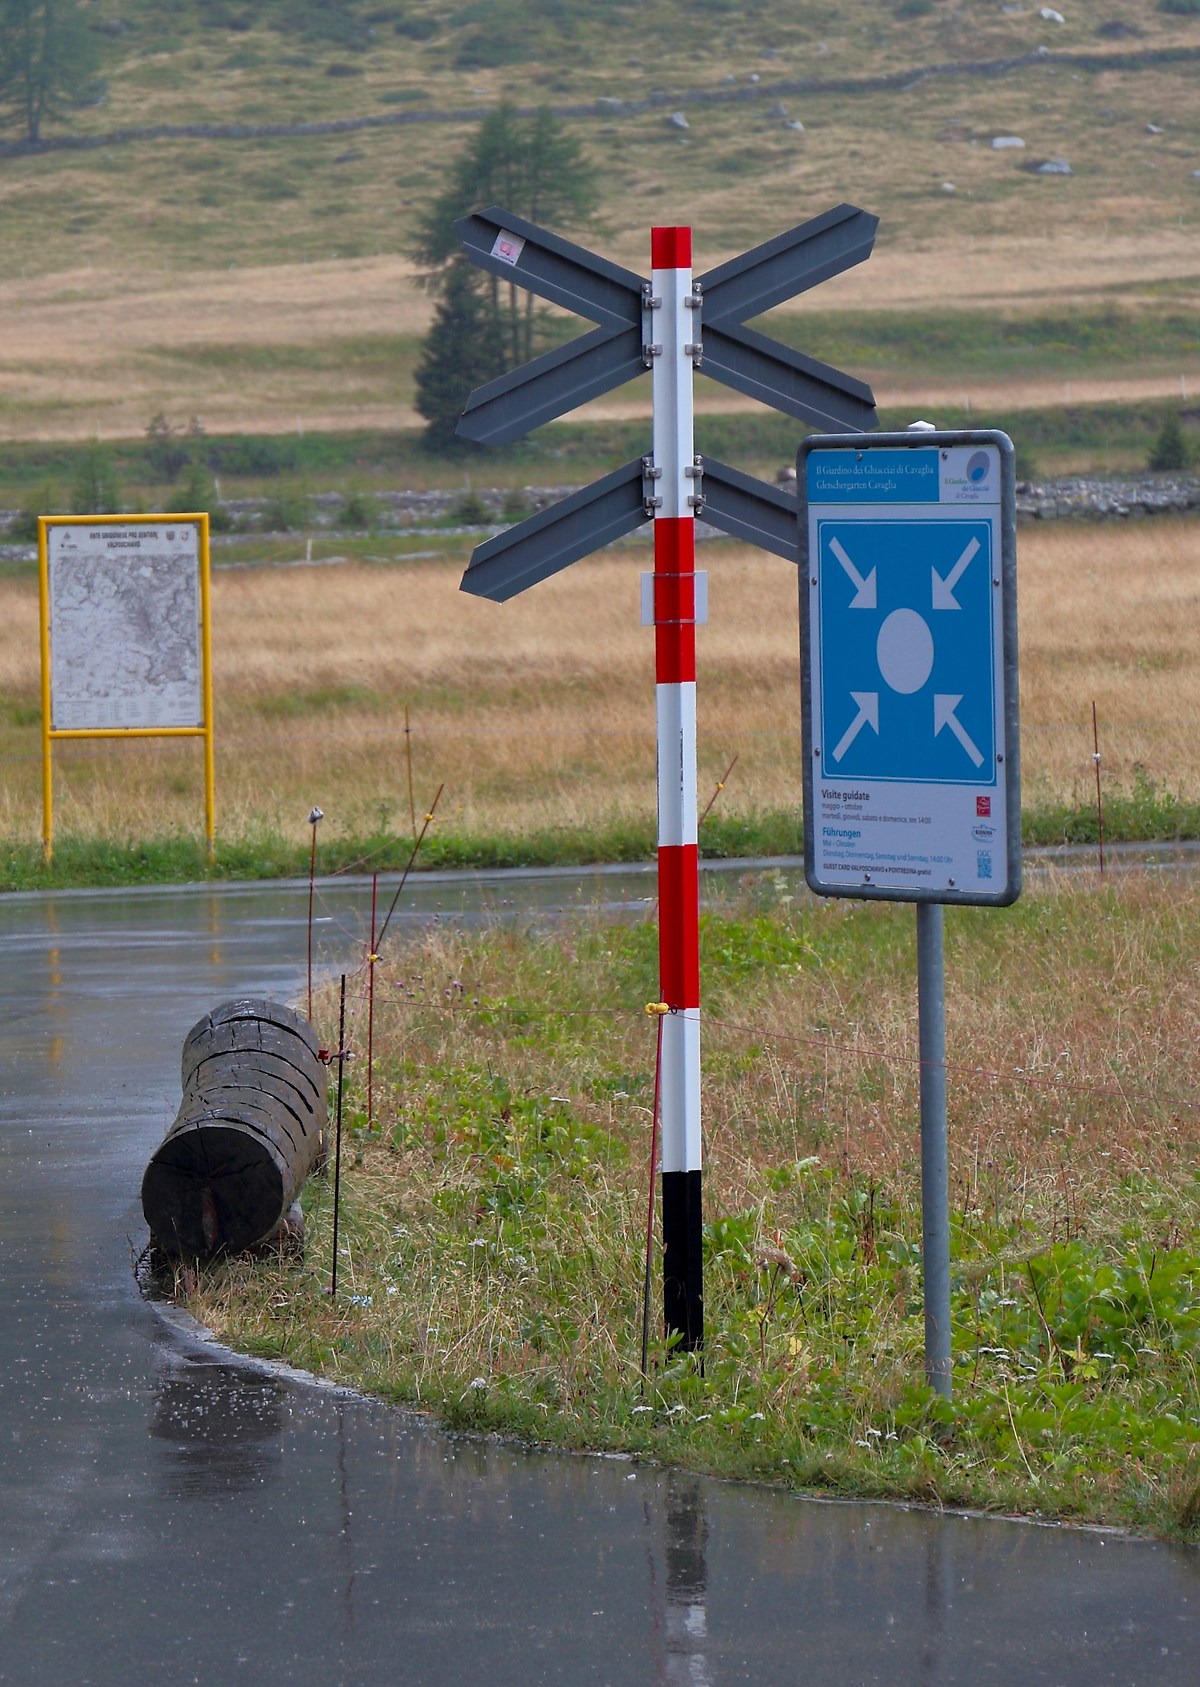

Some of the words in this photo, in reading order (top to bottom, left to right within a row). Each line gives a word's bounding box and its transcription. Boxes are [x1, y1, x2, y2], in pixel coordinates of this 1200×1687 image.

[816, 466, 821, 474] Il
[822, 465, 852, 475] Giardino
[853, 465, 863, 474] dei
[864, 465, 895, 474] Ghiacciai
[896, 464, 904, 474] di
[904, 464, 934, 477] Cavaglia
[816, 480, 867, 492] Gletschergarten
[868, 480, 896, 492] Cavaglia
[821, 789, 841, 799] Visite
[842, 790, 870, 801] guidate
[822, 803, 840, 811] maggio
[845, 803, 863, 811] ottobre
[822, 827, 861, 839] Führungen
[836, 840, 855, 848] Oktober
[897, 852, 906, 861] und
[851, 865, 884, 873] VALPOSCHIAVO
